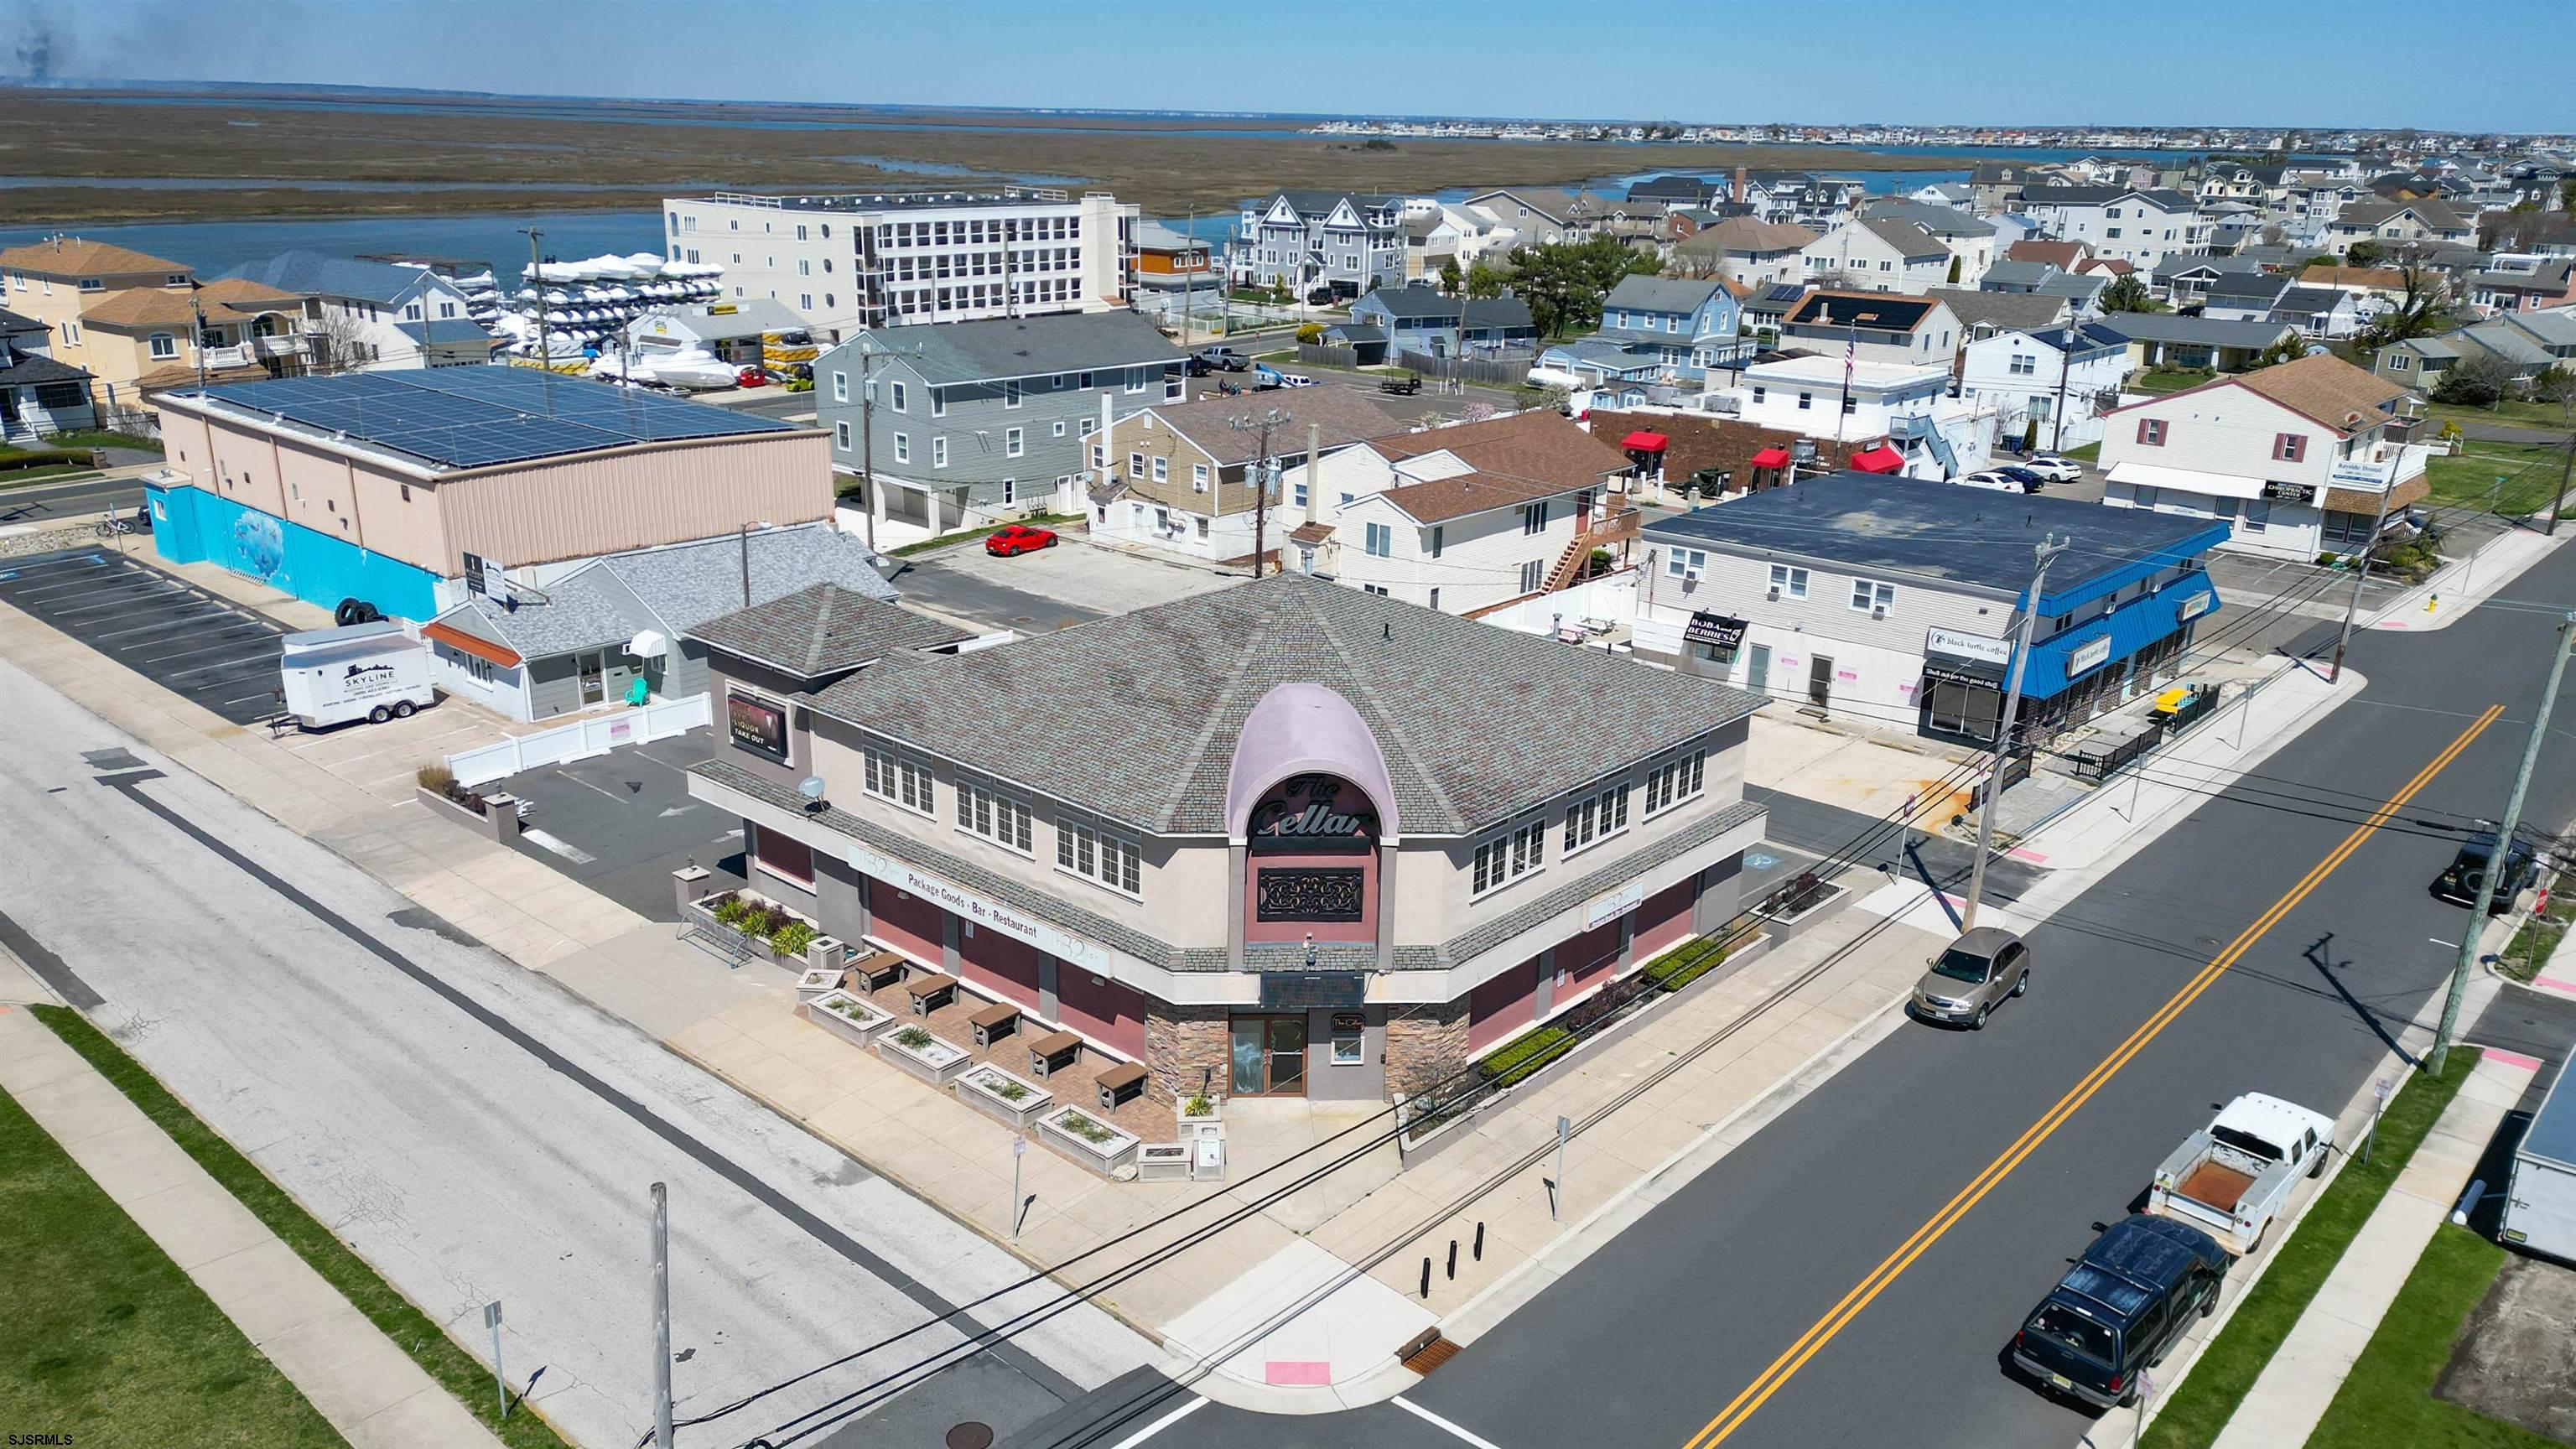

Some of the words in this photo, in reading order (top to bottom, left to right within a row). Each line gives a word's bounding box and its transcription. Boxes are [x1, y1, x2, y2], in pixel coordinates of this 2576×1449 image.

[2267, 484, 2314, 495] CHIROPRACTIC
[1690, 618, 1720, 631] BOBA
[1687, 626, 1729, 641] BERRIES
[1947, 636, 1965, 647] black
[1966, 641, 1985, 652] turtle
[1987, 646, 2007, 656] coffee
[345, 671, 395, 687] SKYLINE
[734, 719, 759, 734] LIQUOR
[735, 728, 750, 739] TAKE
[750, 735, 765, 745] OUT
[1285, 775, 1341, 797] The
[1252, 800, 1375, 836] Cellar
[908, 873, 939, 896] Package
[941, 888, 964, 908] Goods
[972, 901, 986, 917] Bar
[993, 910, 1037, 938] Restaurant
